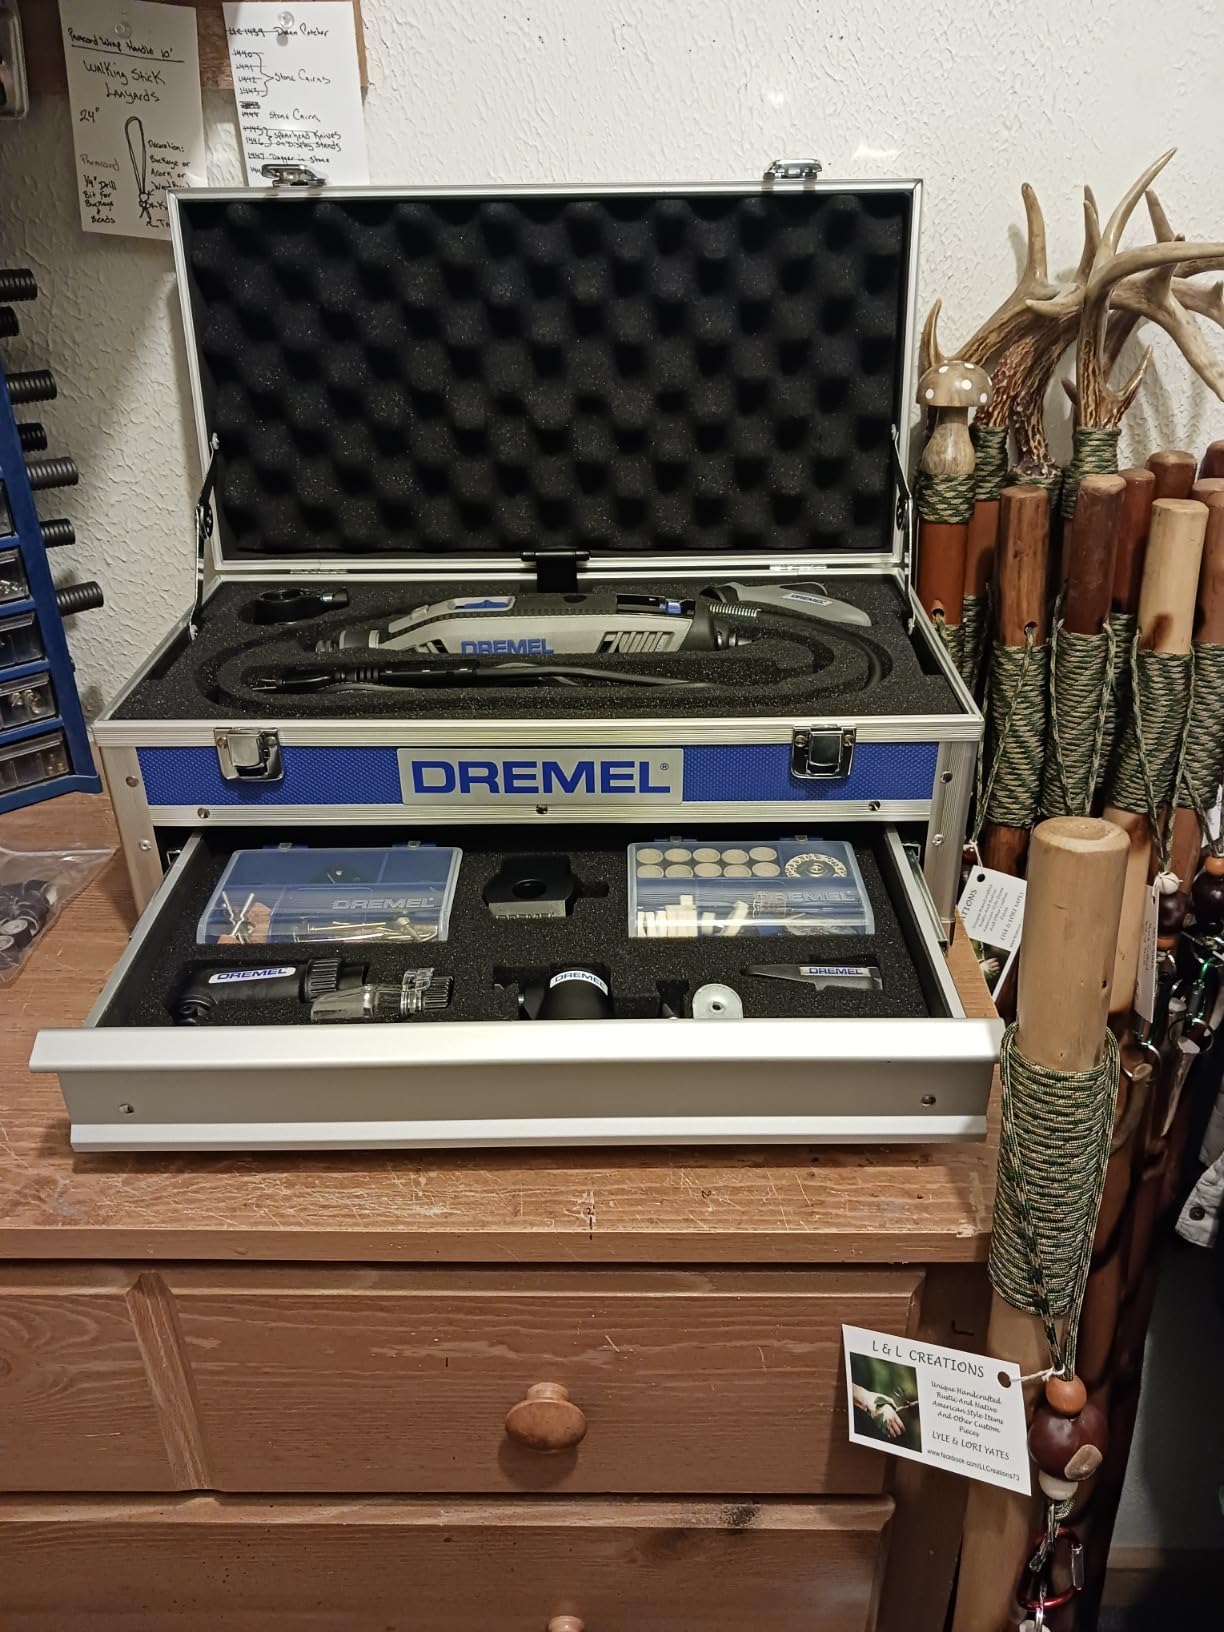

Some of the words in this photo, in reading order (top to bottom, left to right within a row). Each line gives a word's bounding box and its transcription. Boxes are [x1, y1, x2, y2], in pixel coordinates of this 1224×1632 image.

[461, 638, 554, 655] DREMEL
[217, 968, 288, 980] DREMEL
[808, 967, 864, 975] DREMEL
[872, 1340, 879, 1352] L
[882, 1343, 892, 1356] &
[895, 1345, 902, 1358] L
[909, 1349, 984, 1378] CREATIONS
[931, 1380, 956, 1392] Unique
[956, 1387, 1003, 1405] Handcrafted
[936, 1391, 958, 1403] Rustic
[958, 1397, 974, 1407] And
[974, 1401, 998, 1414] Native
[932, 1400, 966, 1414] American
[966, 1409, 984, 1419] Style
[984, 1413, 1004, 1425] Items
[937, 1411, 953, 1420] And
[953, 1414, 973, 1425] Other
[973, 1420, 1001, 1433] Custom
[959, 1425, 980, 1438] Pieces
[932, 1431, 951, 1443] LYLE
[952, 1437, 959, 1446] &
[961, 1439, 982, 1453] LORI
[984, 1445, 1010, 1461] YATES
